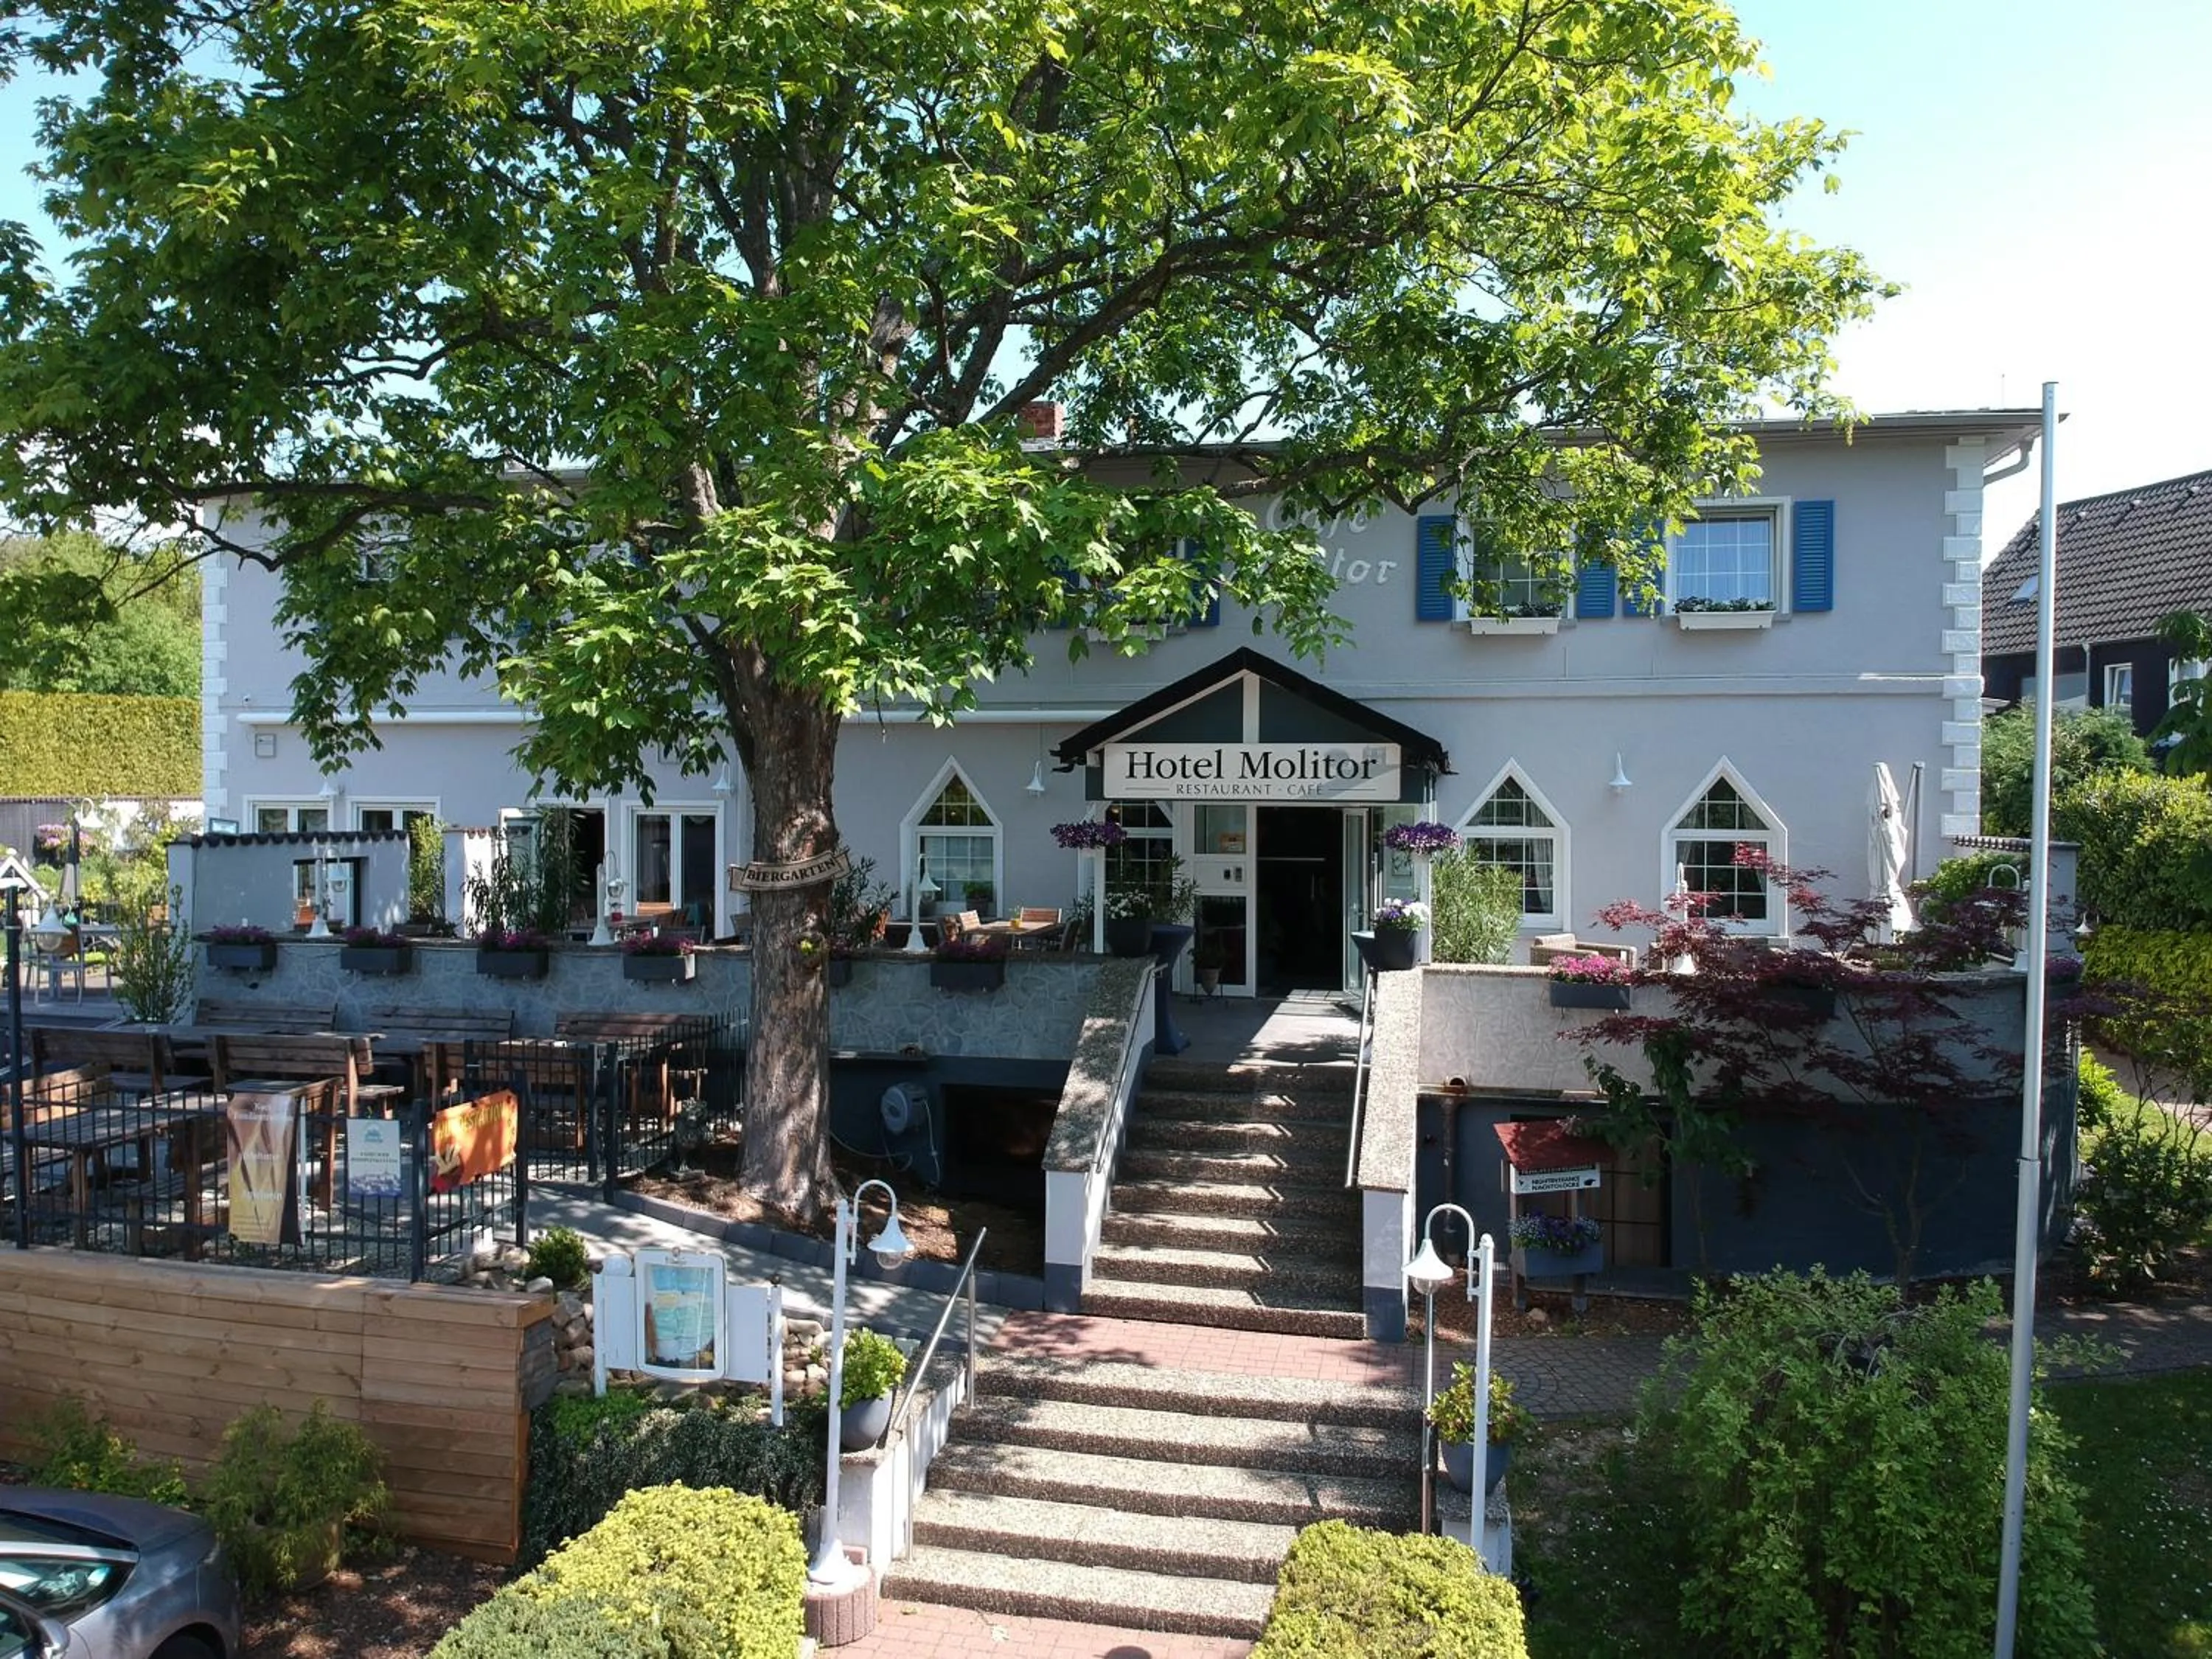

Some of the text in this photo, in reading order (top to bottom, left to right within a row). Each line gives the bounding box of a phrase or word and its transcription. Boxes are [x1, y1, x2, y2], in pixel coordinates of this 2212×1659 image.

[1125, 748, 1377, 779] Hotel Molitor
[1176, 783, 1272, 795] RESTAURANT
[747, 859, 835, 882] BIERGARTEN
